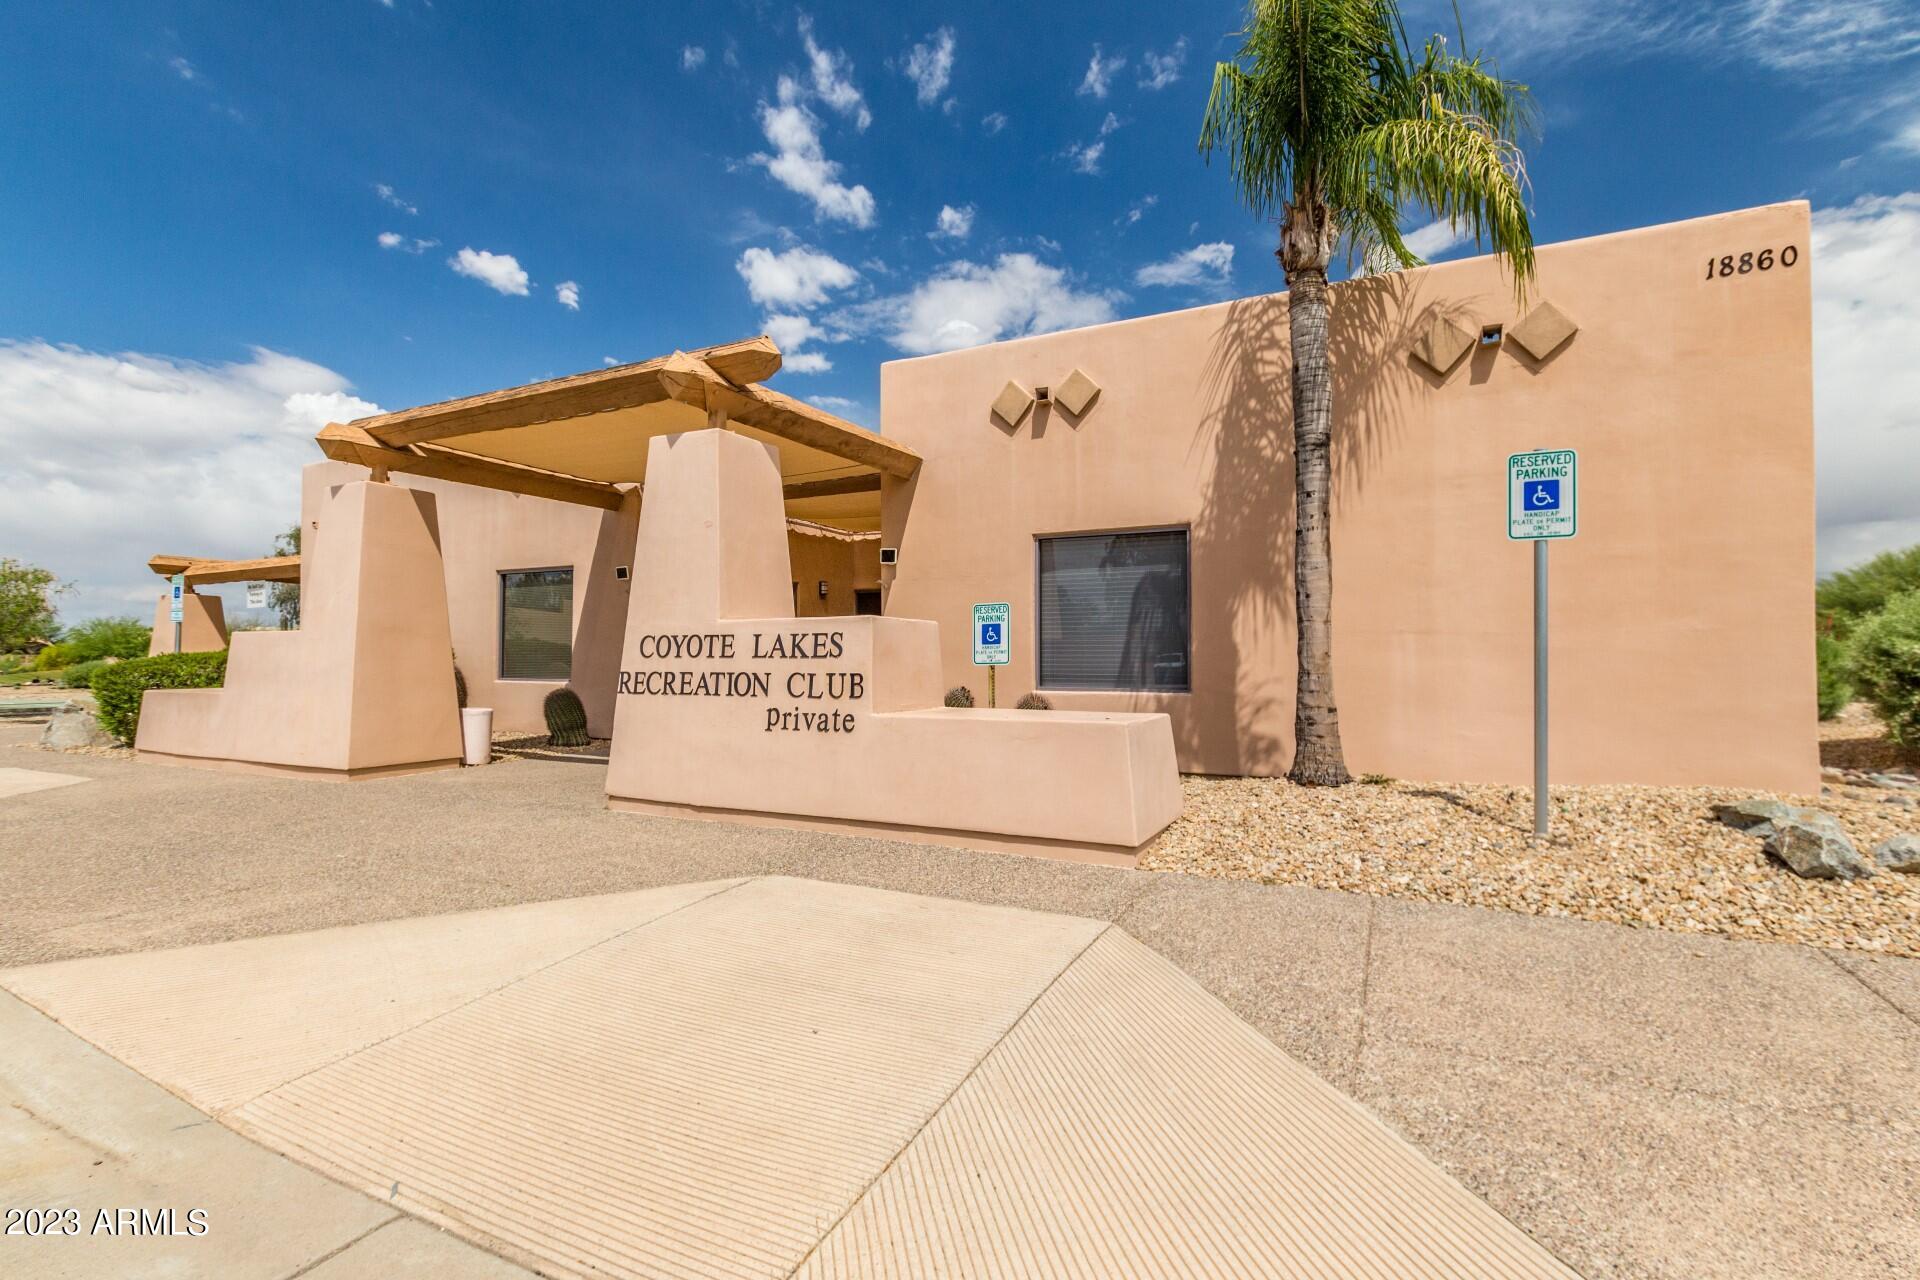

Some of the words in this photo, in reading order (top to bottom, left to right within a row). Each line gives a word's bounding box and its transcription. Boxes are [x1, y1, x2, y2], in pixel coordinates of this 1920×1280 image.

[1705, 245, 1798, 280] 18860
[1512, 453, 1572, 468] RESERVED
[1516, 466, 1568, 480] PARKING
[1524, 510, 1560, 518] HANDICAP
[1546, 516, 1571, 524] PERMIT
[975, 605, 1007, 615] RESERVED
[978, 614, 1005, 623] PARKING
[639, 634, 735, 659] COYOTE
[752, 632, 843, 659] LAKES
[617, 671, 771, 697] RECREATION
[786, 672, 864, 699] CLUB
